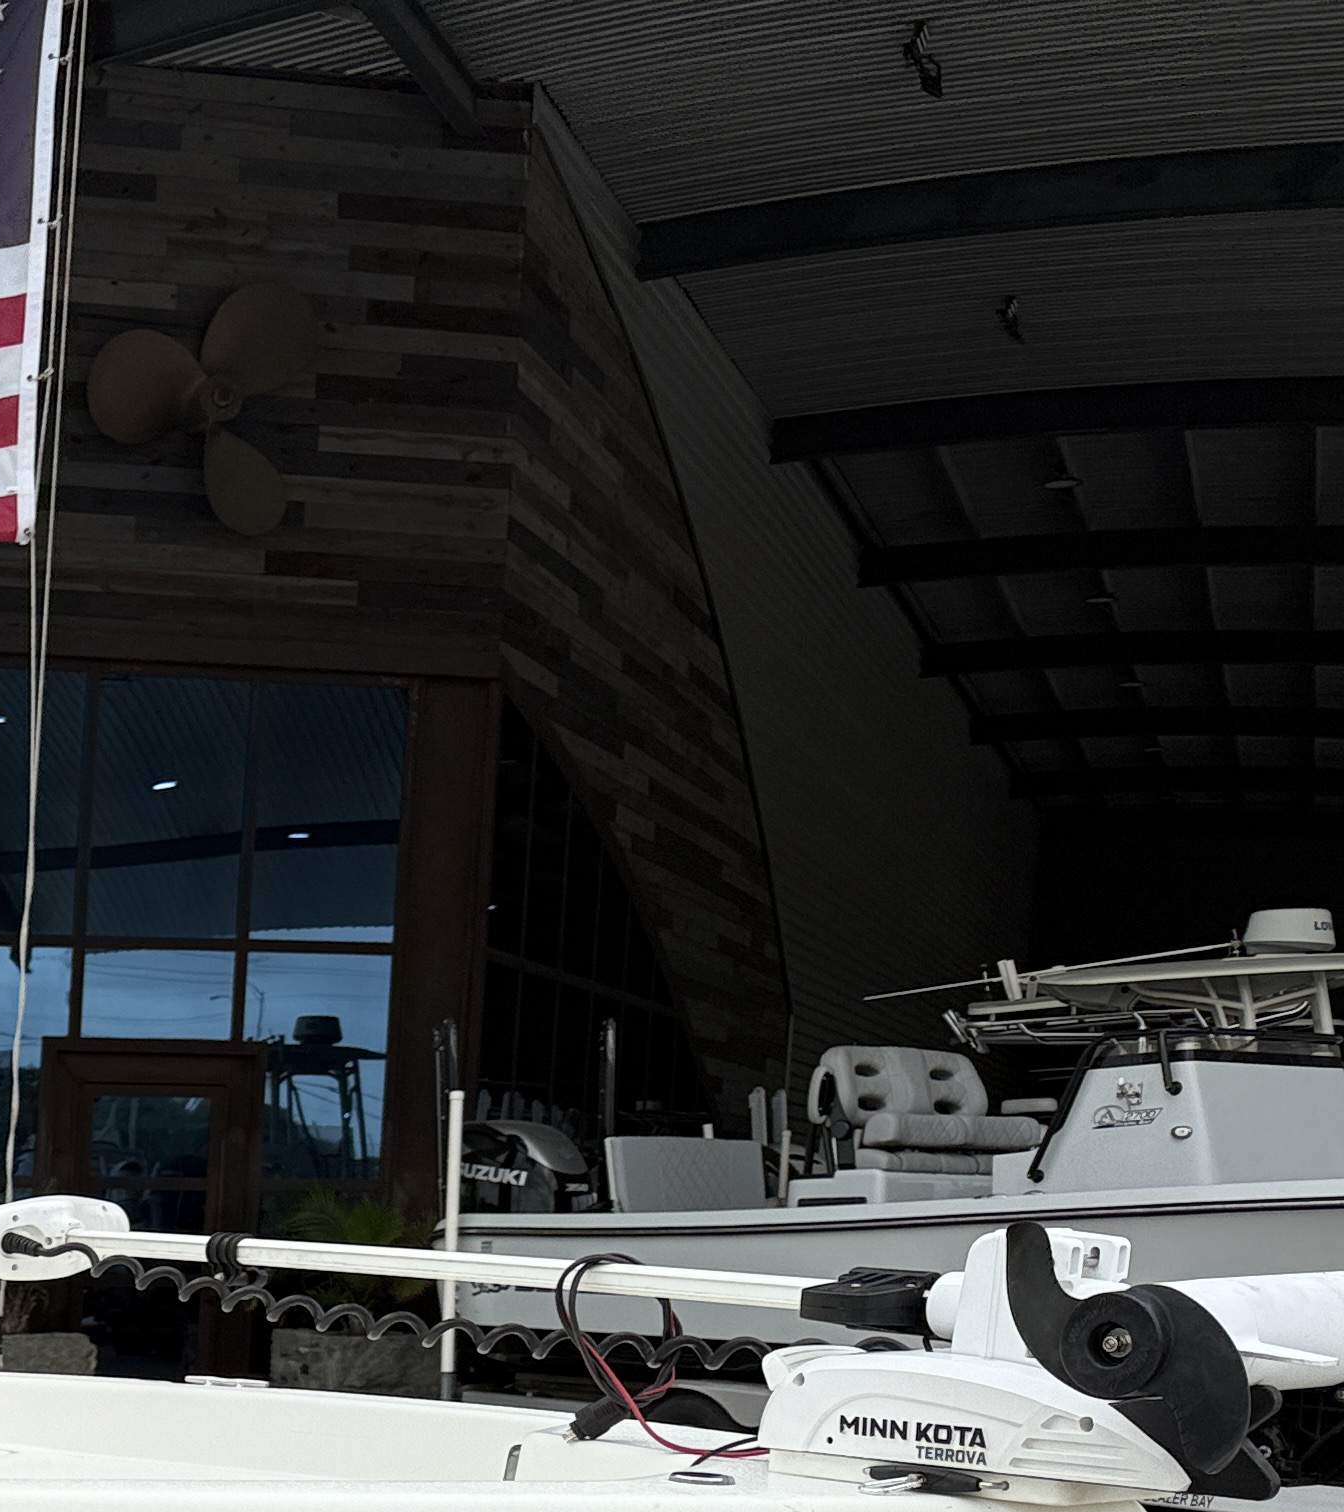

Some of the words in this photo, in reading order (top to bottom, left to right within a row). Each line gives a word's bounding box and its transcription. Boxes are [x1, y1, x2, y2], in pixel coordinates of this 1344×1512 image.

[839, 1414, 909, 1441] MINN
[915, 1421, 987, 1449] KOTA
[915, 1445, 988, 1466] TERROVA
[1190, 1493, 1215, 1509] BAY
